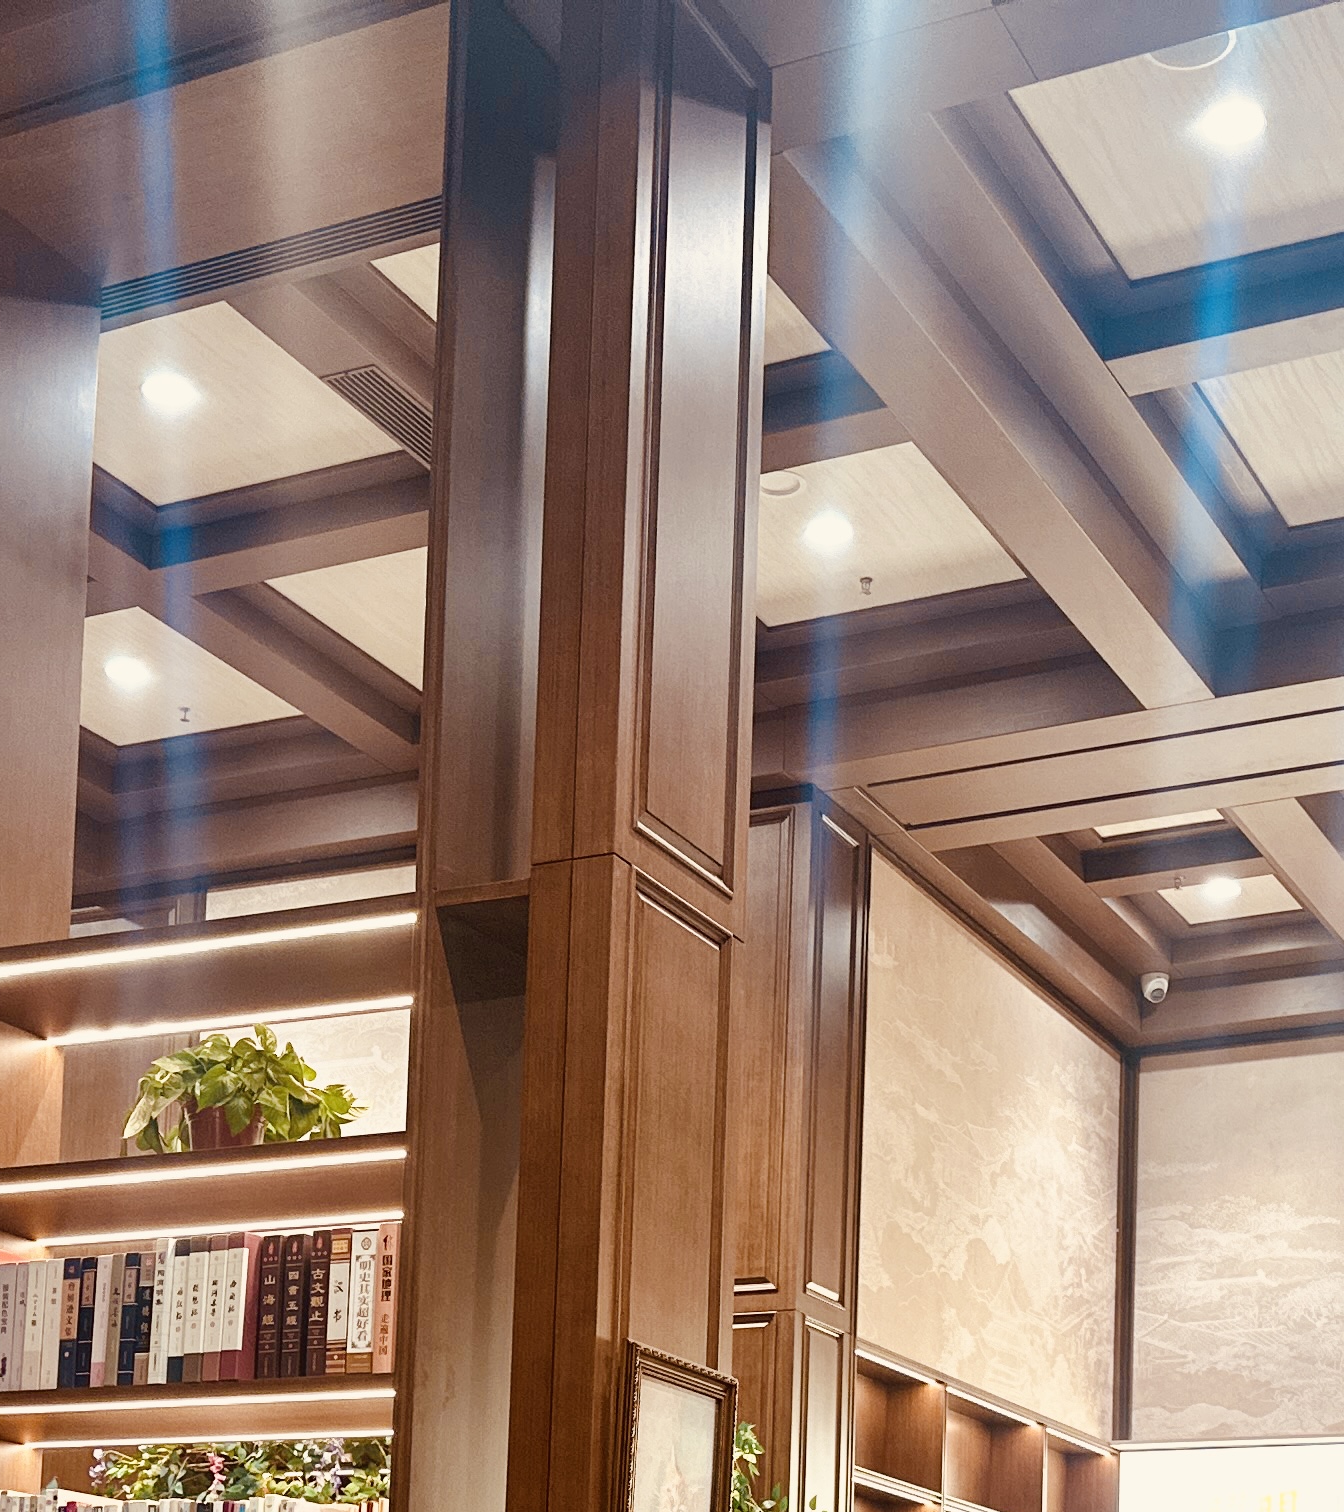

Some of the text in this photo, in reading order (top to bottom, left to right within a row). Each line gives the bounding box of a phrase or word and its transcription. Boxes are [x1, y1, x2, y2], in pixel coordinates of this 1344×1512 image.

[309, 1268, 326, 1322] 古文觀止
[357, 1260, 372, 1342] 明史其实超好看
